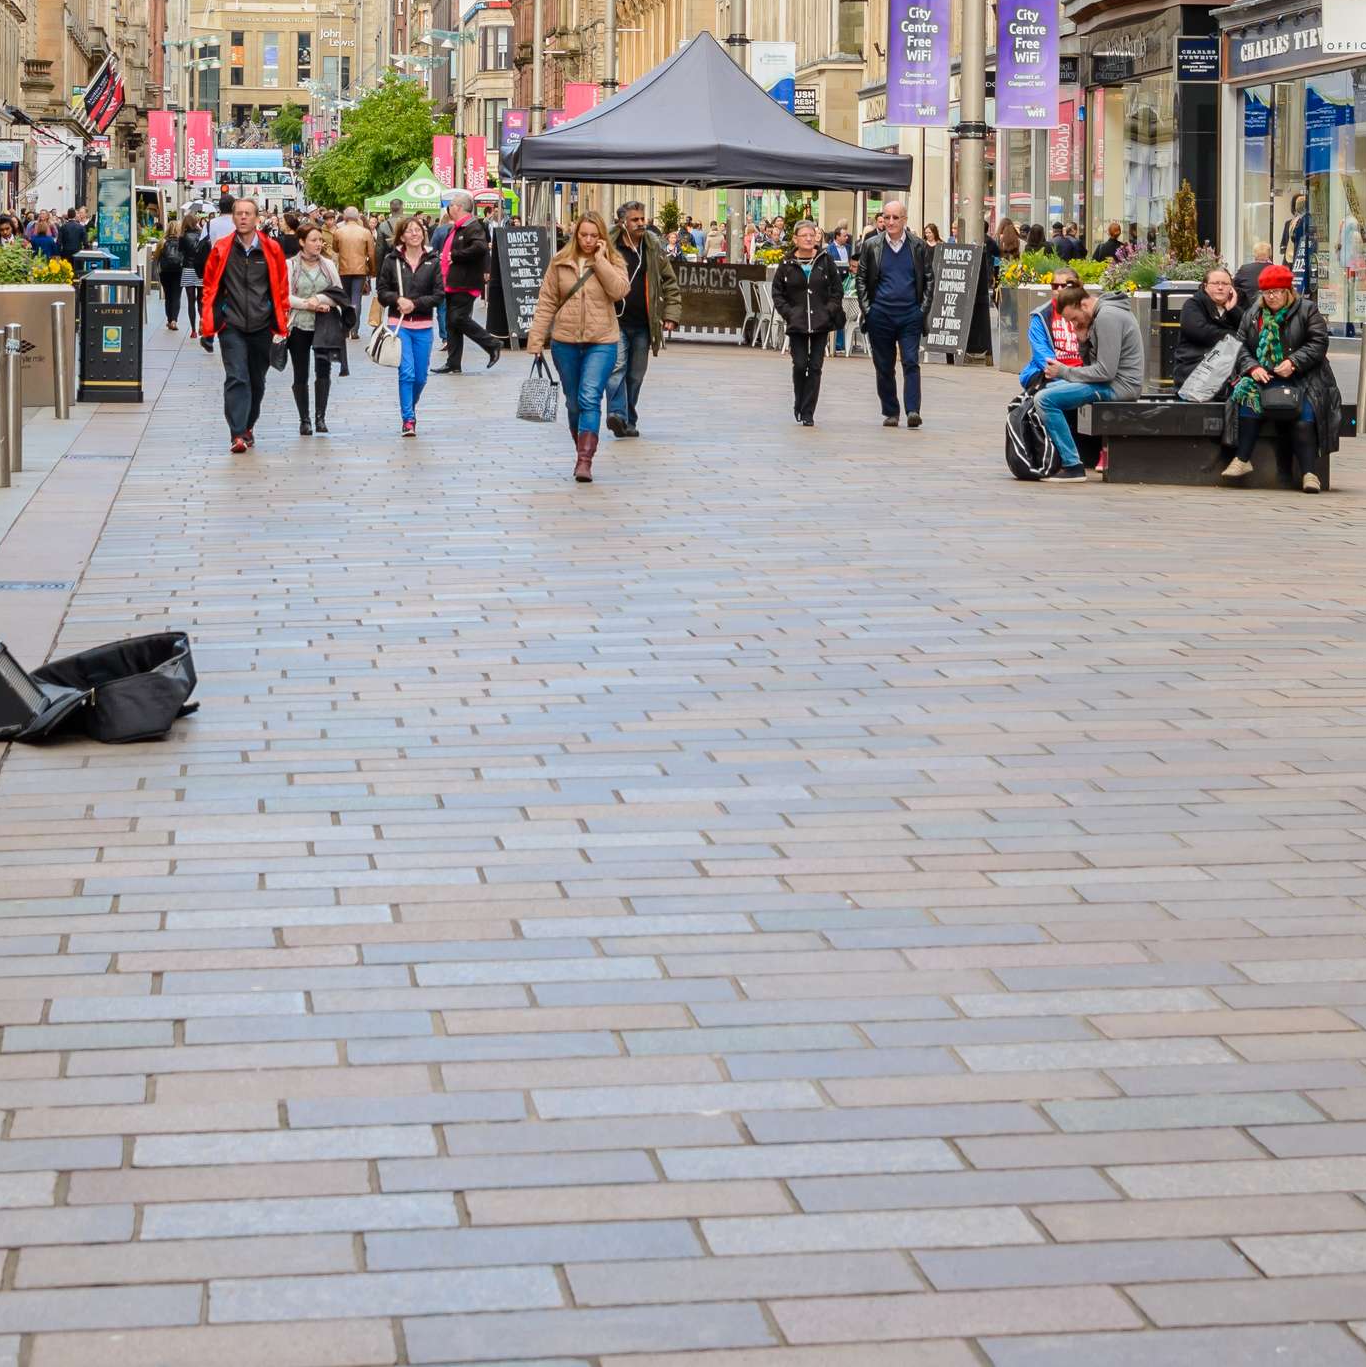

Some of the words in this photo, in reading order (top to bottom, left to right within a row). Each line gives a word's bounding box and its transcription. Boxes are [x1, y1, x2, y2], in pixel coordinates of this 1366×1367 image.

[908, 7, 932, 22] City
[1016, 8, 1039, 24] City
[901, 20, 939, 34] Centre
[1009, 22, 1047, 35] Centre
[319, 28, 340, 41] John
[329, 39, 355, 47] Lewis
[906, 35, 932, 48] Free
[1015, 37, 1040, 49] Free
[1240, 34, 1290, 63] CHARLES
[906, 49, 932, 62] WiFi
[1014, 51, 1040, 64] WiFi
[917, 105, 937, 117] wifi
[1027, 107, 1046, 119] wifi
[149, 137, 157, 177] GLASGOW
[163, 148, 172, 177] PEOPLE
[187, 137, 195, 177] GLASGOW
[201, 148, 209, 177] PEOPLE
[156, 154, 164, 177] MAKE
[194, 154, 202, 177] MAKE
[506, 232, 539, 244] DARCY'S
[943, 248, 973, 261] DARCY'S
[678, 266, 737, 288] DARCY'S
[941, 268, 966, 280] COCKTAILS
[944, 293, 959, 305] FIZZ
[941, 305, 957, 318] WINE
[932, 317, 944, 329] SOFT
